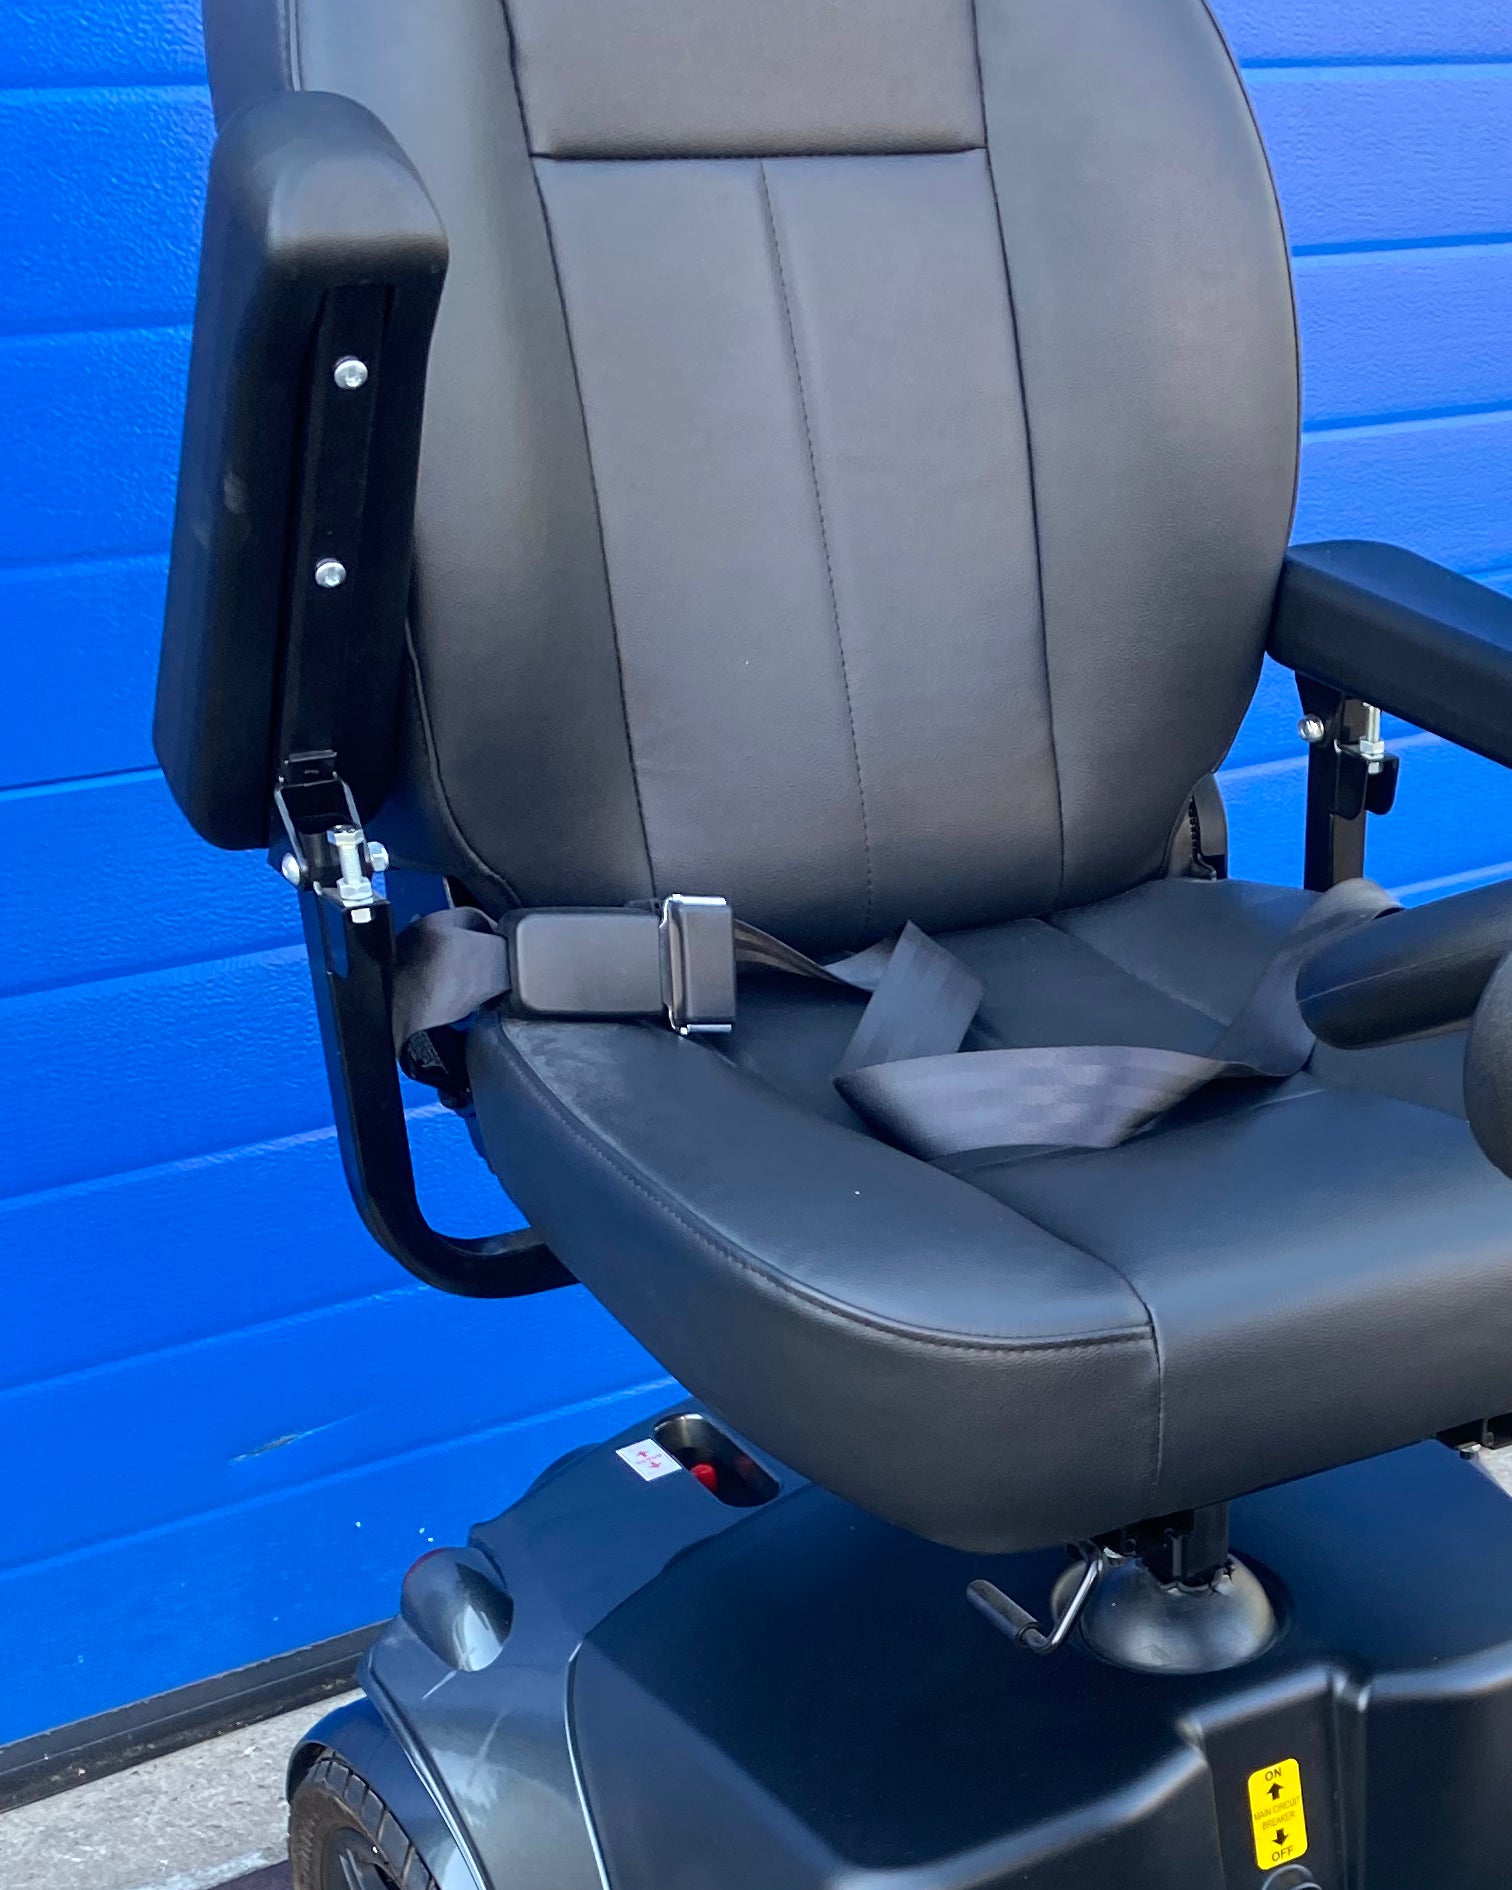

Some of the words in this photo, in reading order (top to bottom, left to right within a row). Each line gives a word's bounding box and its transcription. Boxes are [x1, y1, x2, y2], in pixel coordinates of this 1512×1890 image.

[1264, 1767, 1282, 1782] ON
[1254, 1807, 1272, 1821] MAIN
[1273, 1795, 1300, 1814] CIRCUIT
[1262, 1810, 1296, 1830] BREAKER
[1271, 1845, 1294, 1862] OFF
